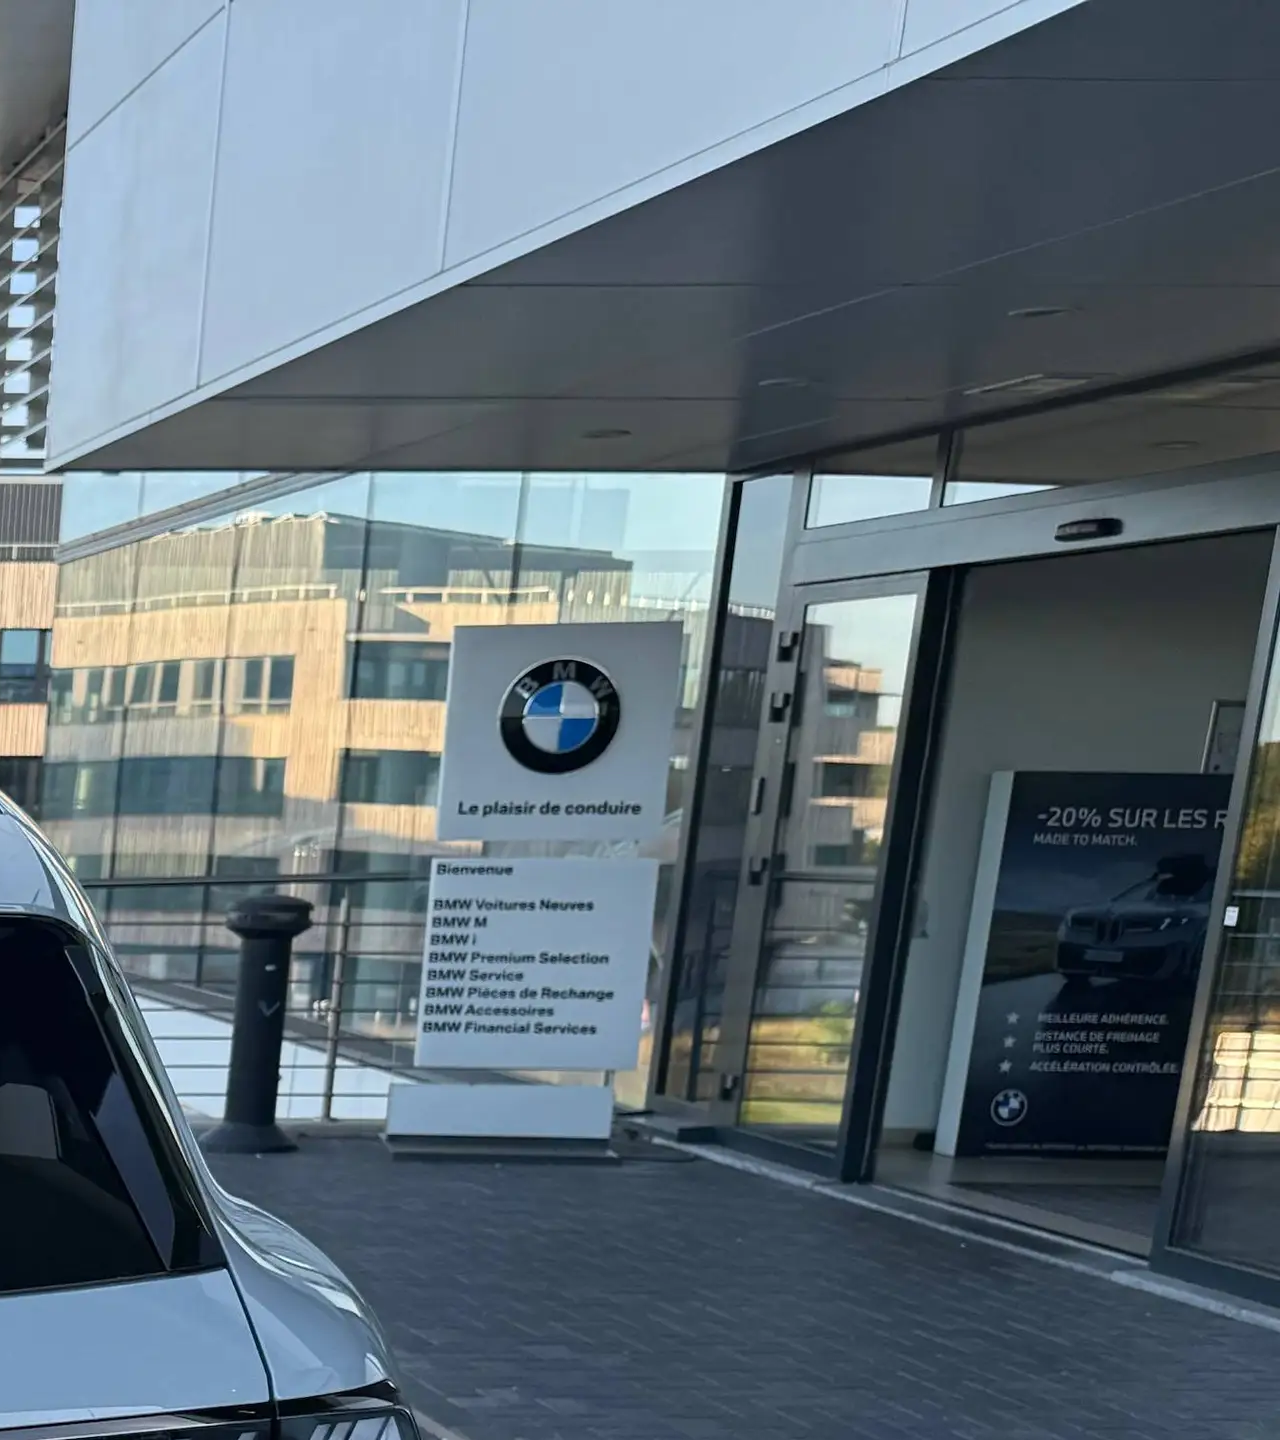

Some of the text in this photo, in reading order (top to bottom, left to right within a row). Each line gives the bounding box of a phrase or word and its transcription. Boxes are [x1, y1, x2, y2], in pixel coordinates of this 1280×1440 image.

[515, 661, 614, 699] BMW
[458, 801, 643, 818] Le plaisir de conduire
[1037, 807, 1102, 828] -20%
[1108, 807, 1158, 829] SUR
[1163, 809, 1208, 829] LES
[1033, 833, 1138, 846] MADE TO MATCH.
[436, 863, 514, 876] Bienvenue
[433, 899, 595, 912] BMW Voitures Neuves
[431, 916, 488, 928] BMW M
[430, 934, 469, 945] BMW
[428, 951, 610, 964] BMW Premium Selection
[427, 969, 524, 982] BMW Service
[425, 987, 464, 999] BMW
[519, 988, 538, 999] de
[541, 987, 614, 1002] Rechange
[424, 1004, 554, 1017] BMW Accessoires
[1037, 1013, 1099, 1024] MEILLEURE
[422, 1022, 597, 1035] BMW Financial Services
[1034, 1031, 1088, 1042] DISTANCE
[1090, 1032, 1104, 1042] DE
[1032, 1043, 1060, 1053] PLUS
